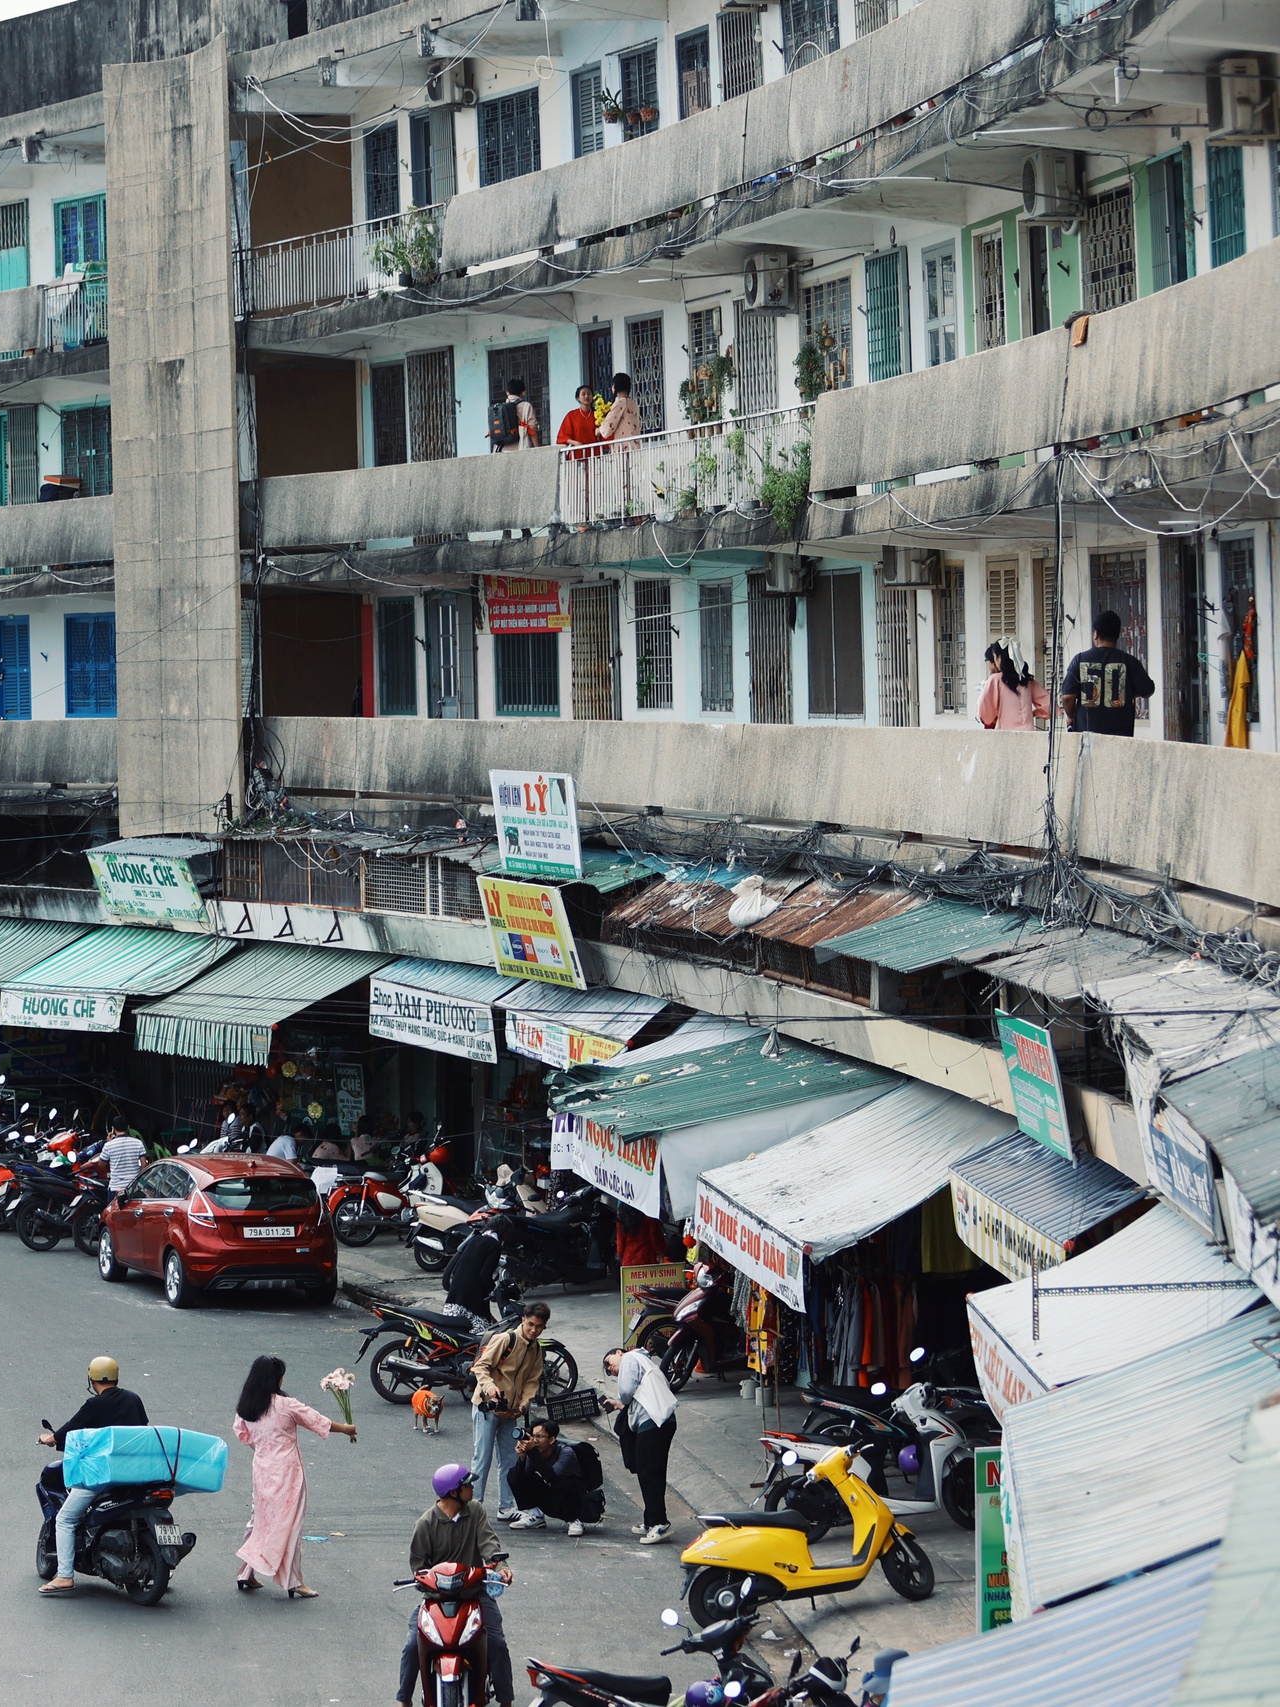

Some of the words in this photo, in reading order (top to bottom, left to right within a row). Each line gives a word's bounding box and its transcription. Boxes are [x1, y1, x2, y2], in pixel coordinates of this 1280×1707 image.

[1079, 662, 1126, 708] 50
[523, 775, 548, 815] LÝ
[483, 883, 502, 917] LÝ
[489, 917, 507, 929] MOBILE
[372, 987, 392, 1012] Shop
[395, 992, 422, 1020] NAM
[426, 998, 476, 1033] PHƯƠNG
[421, 1025, 436, 1038] TRANG
[527, 1025, 543, 1049] LEN
[569, 1032, 585, 1062] LÝ
[585, 1118, 616, 1163] NGỌC
[248, 1228, 291, 1236] 79A-011.25
[740, 1224, 761, 1266] CHỢ
[763, 1236, 786, 1280] ĐẦM
[631, 1270, 647, 1280] MEN
[650, 1270, 657, 1278] VI
[660, 1268, 677, 1277] SINH
[986, 1460, 1001, 1487] N
